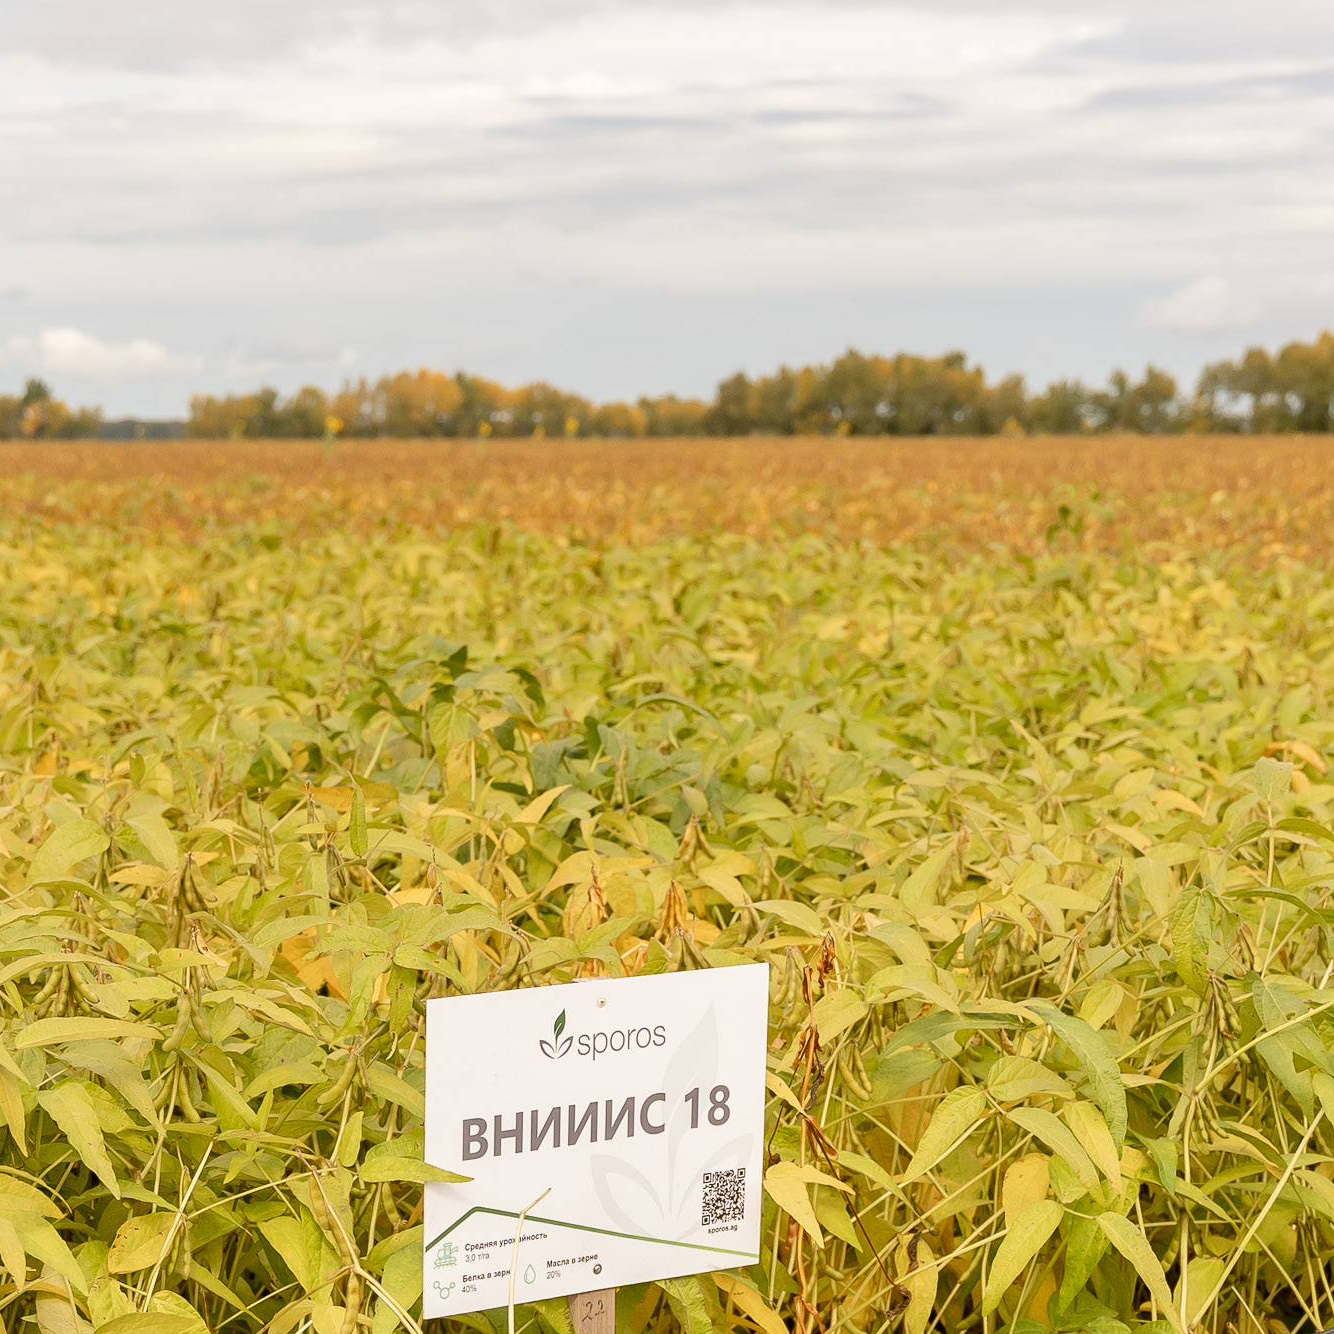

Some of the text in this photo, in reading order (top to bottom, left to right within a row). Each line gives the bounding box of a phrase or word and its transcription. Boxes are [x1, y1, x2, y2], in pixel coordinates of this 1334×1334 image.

[577, 1025, 666, 1061] sporos
[462, 1084, 730, 1161] ВНИИИС 18
[708, 1224, 738, 1235] sporos.ag
[465, 1240, 497, 1252] Средняя
[465, 1254, 475, 1263] 3,0
[547, 1259, 570, 1268] Масла
[578, 1254, 598, 1263] зерне
[462, 1273, 485, 1283] Белка
[493, 1269, 513, 1278] зерн
[547, 1270, 561, 1280] 20%
[462, 1285, 477, 1293] 40%
